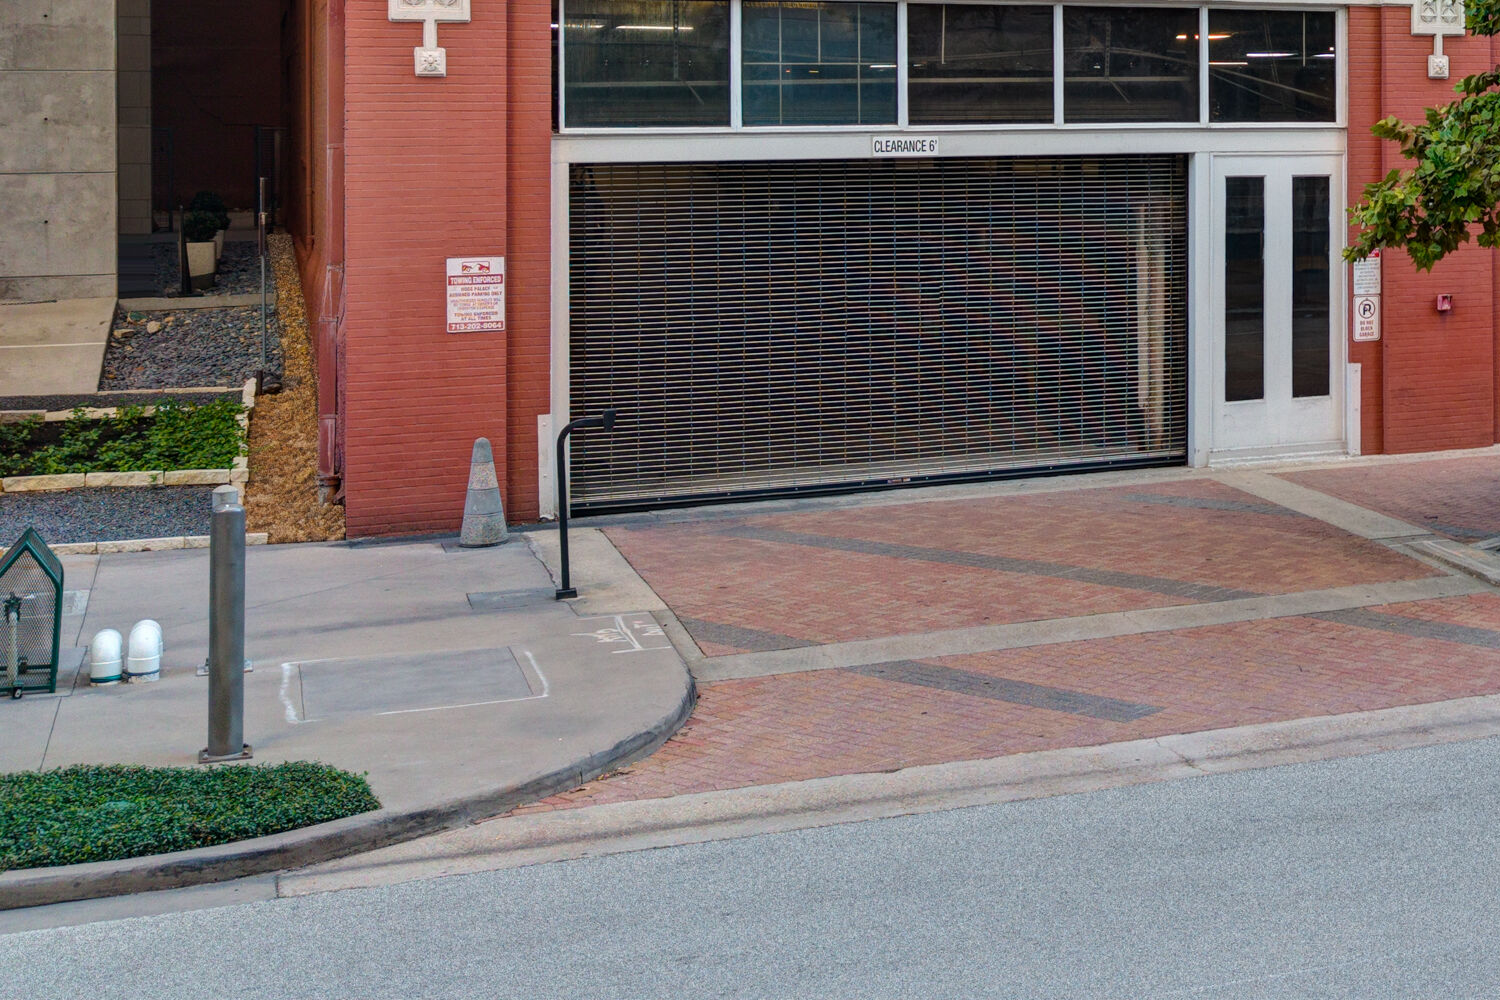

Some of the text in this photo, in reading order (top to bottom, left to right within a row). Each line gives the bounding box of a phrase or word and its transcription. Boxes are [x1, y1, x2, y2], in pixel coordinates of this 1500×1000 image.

[874, 139, 938, 153] CLEARANCE 6'
[450, 275, 502, 285] TOWING ENFORCED
